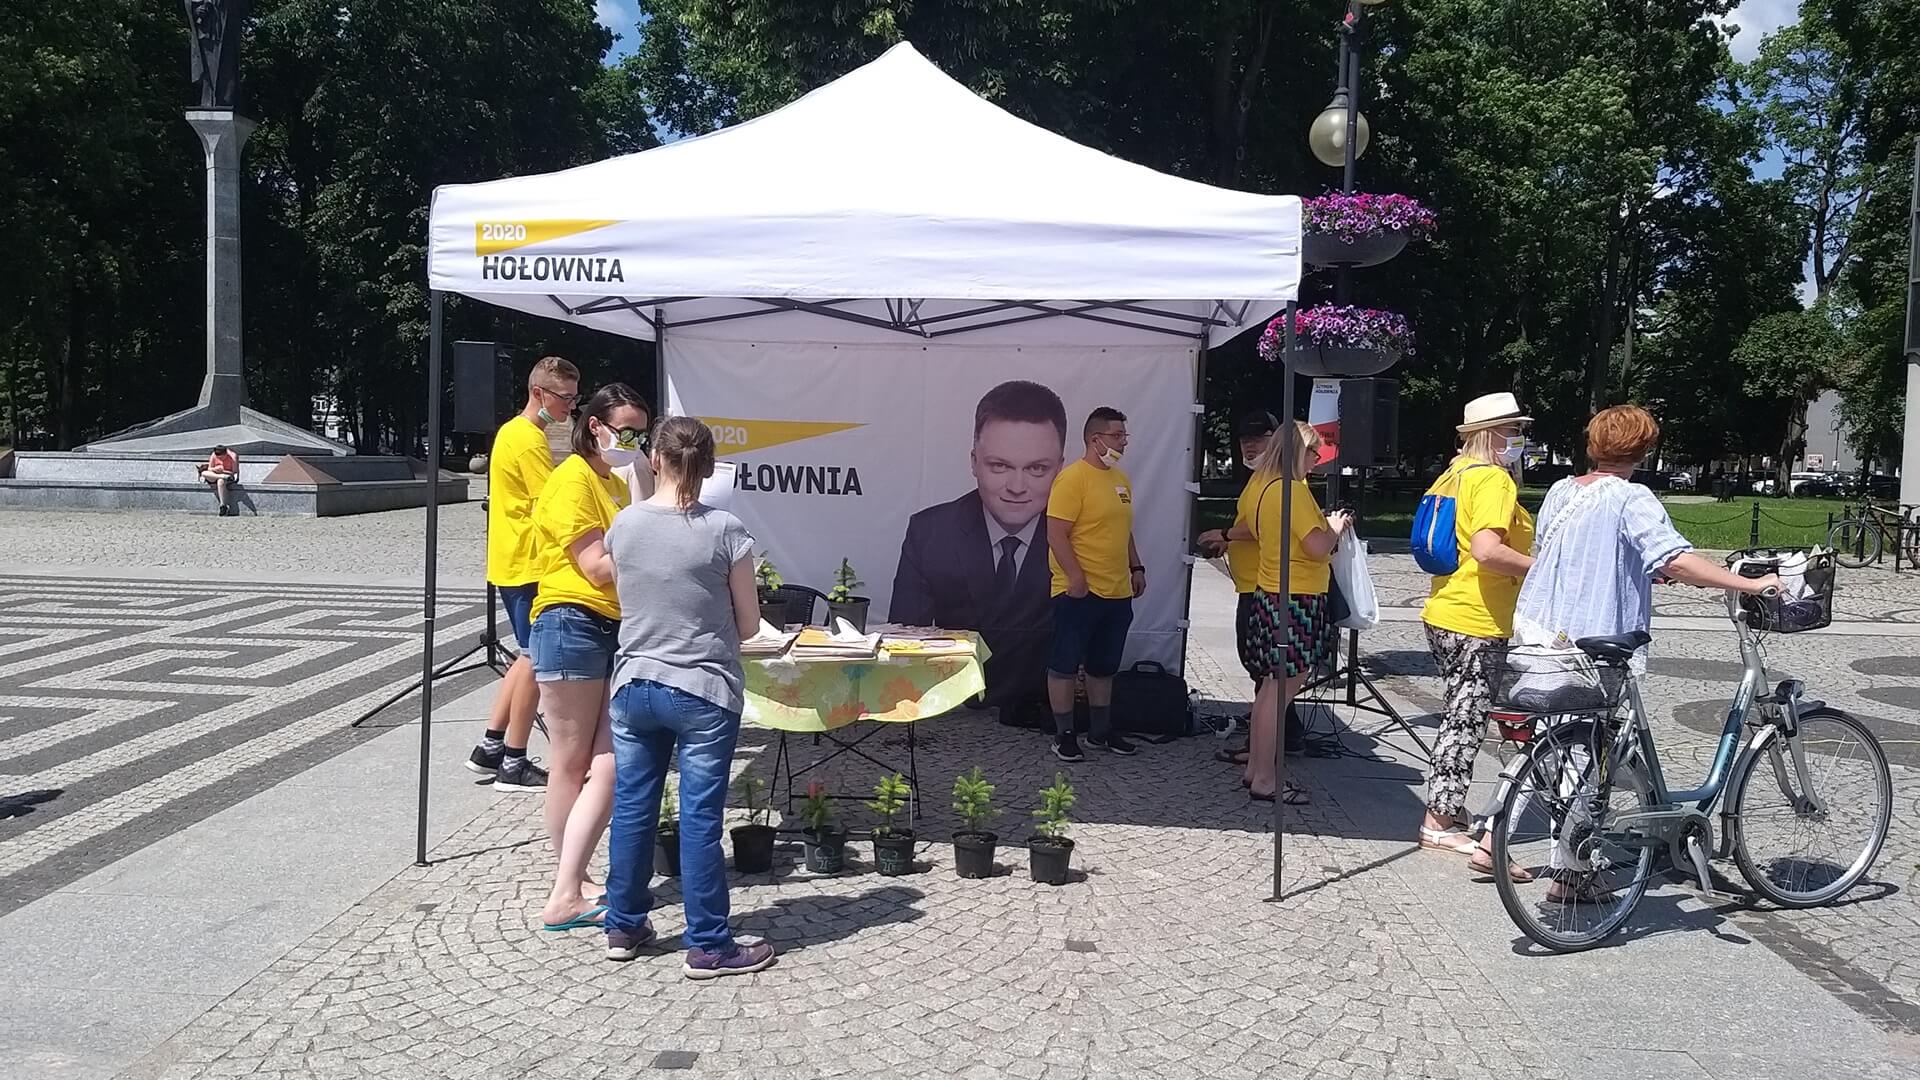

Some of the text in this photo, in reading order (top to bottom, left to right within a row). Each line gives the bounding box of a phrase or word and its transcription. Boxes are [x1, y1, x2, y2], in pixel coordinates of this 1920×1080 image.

[482, 224, 526, 240] 2020
[482, 256, 624, 282] HOŁOWNIA
[710, 425, 747, 445] 020
[721, 461, 862, 495] ŁOWNIA
